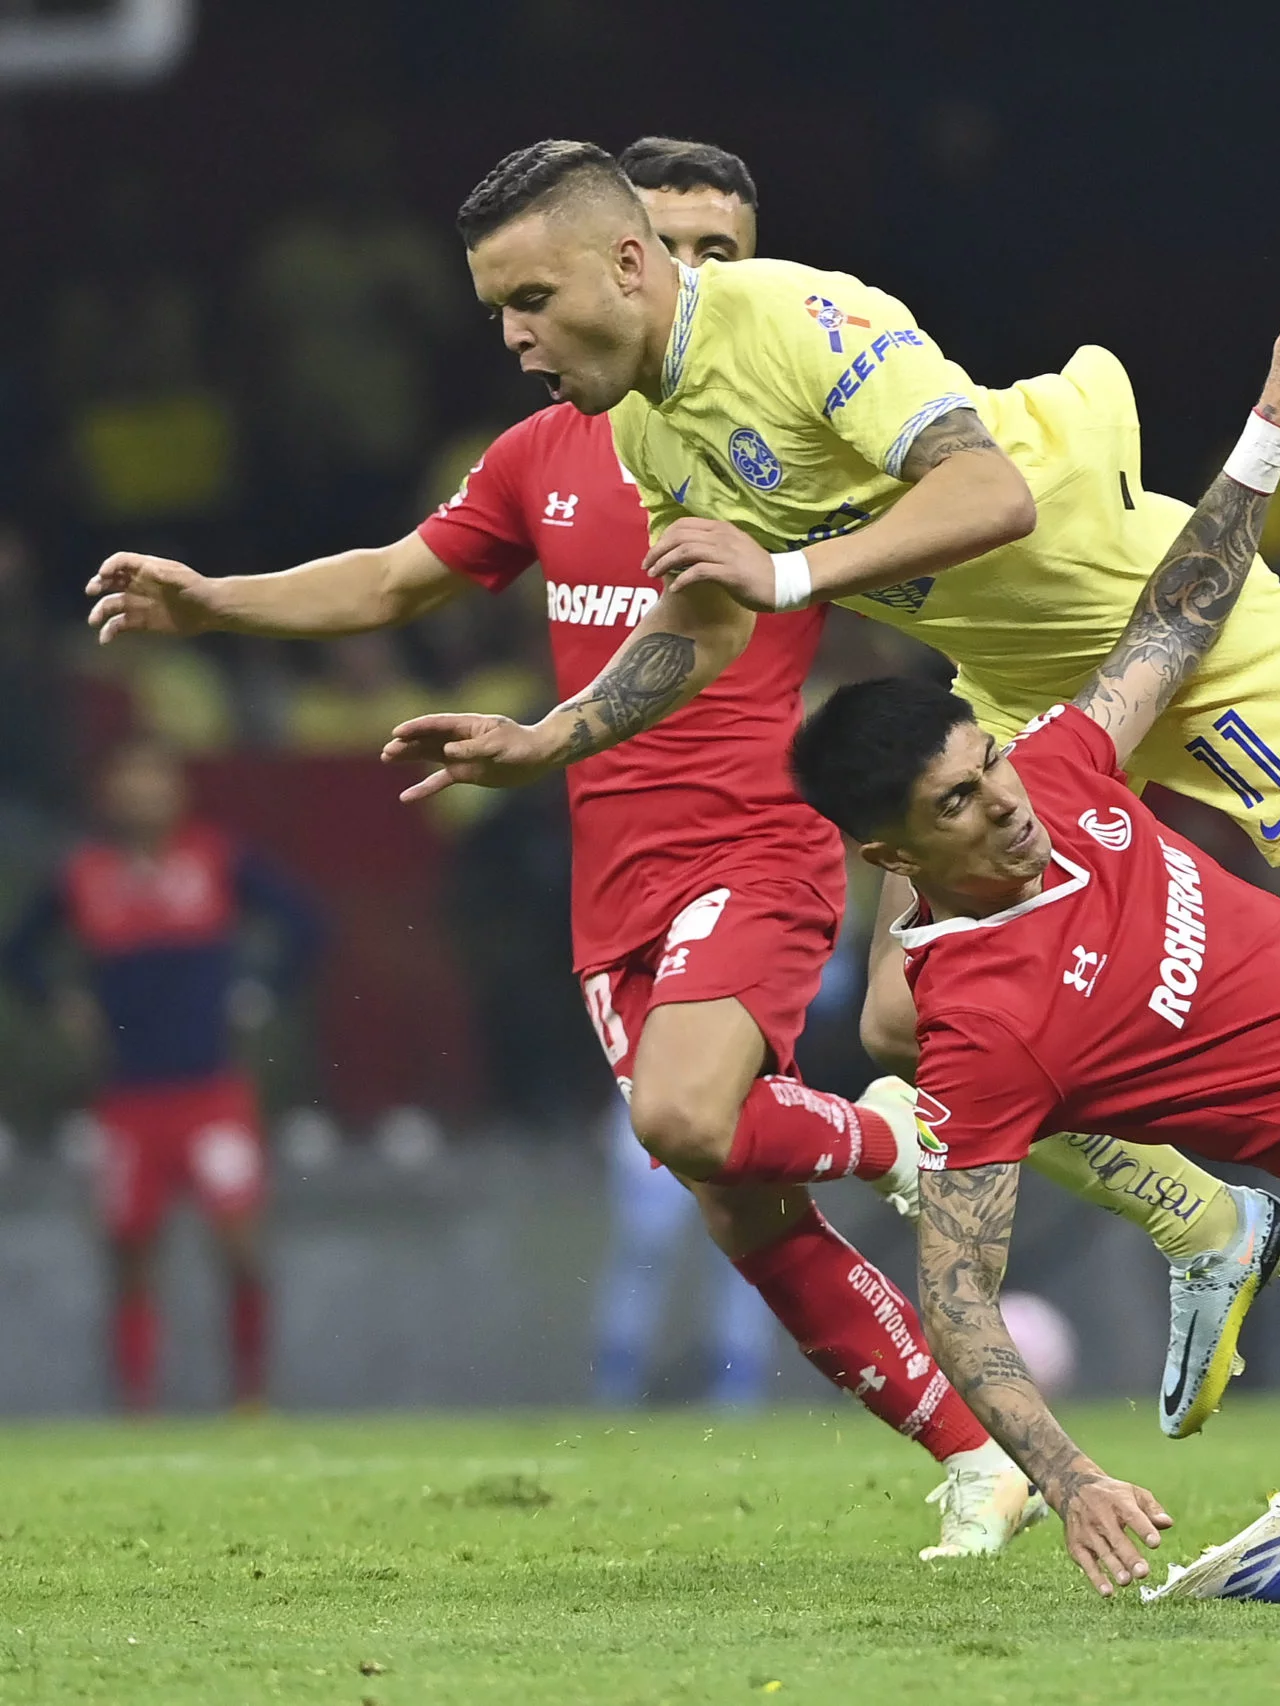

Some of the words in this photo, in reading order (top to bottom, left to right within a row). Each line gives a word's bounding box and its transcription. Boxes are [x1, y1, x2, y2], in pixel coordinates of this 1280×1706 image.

[822, 351, 875, 420] REE
[546, 581, 660, 627] ROSHFR
[1148, 836, 1207, 1030] ROSHFRAN
